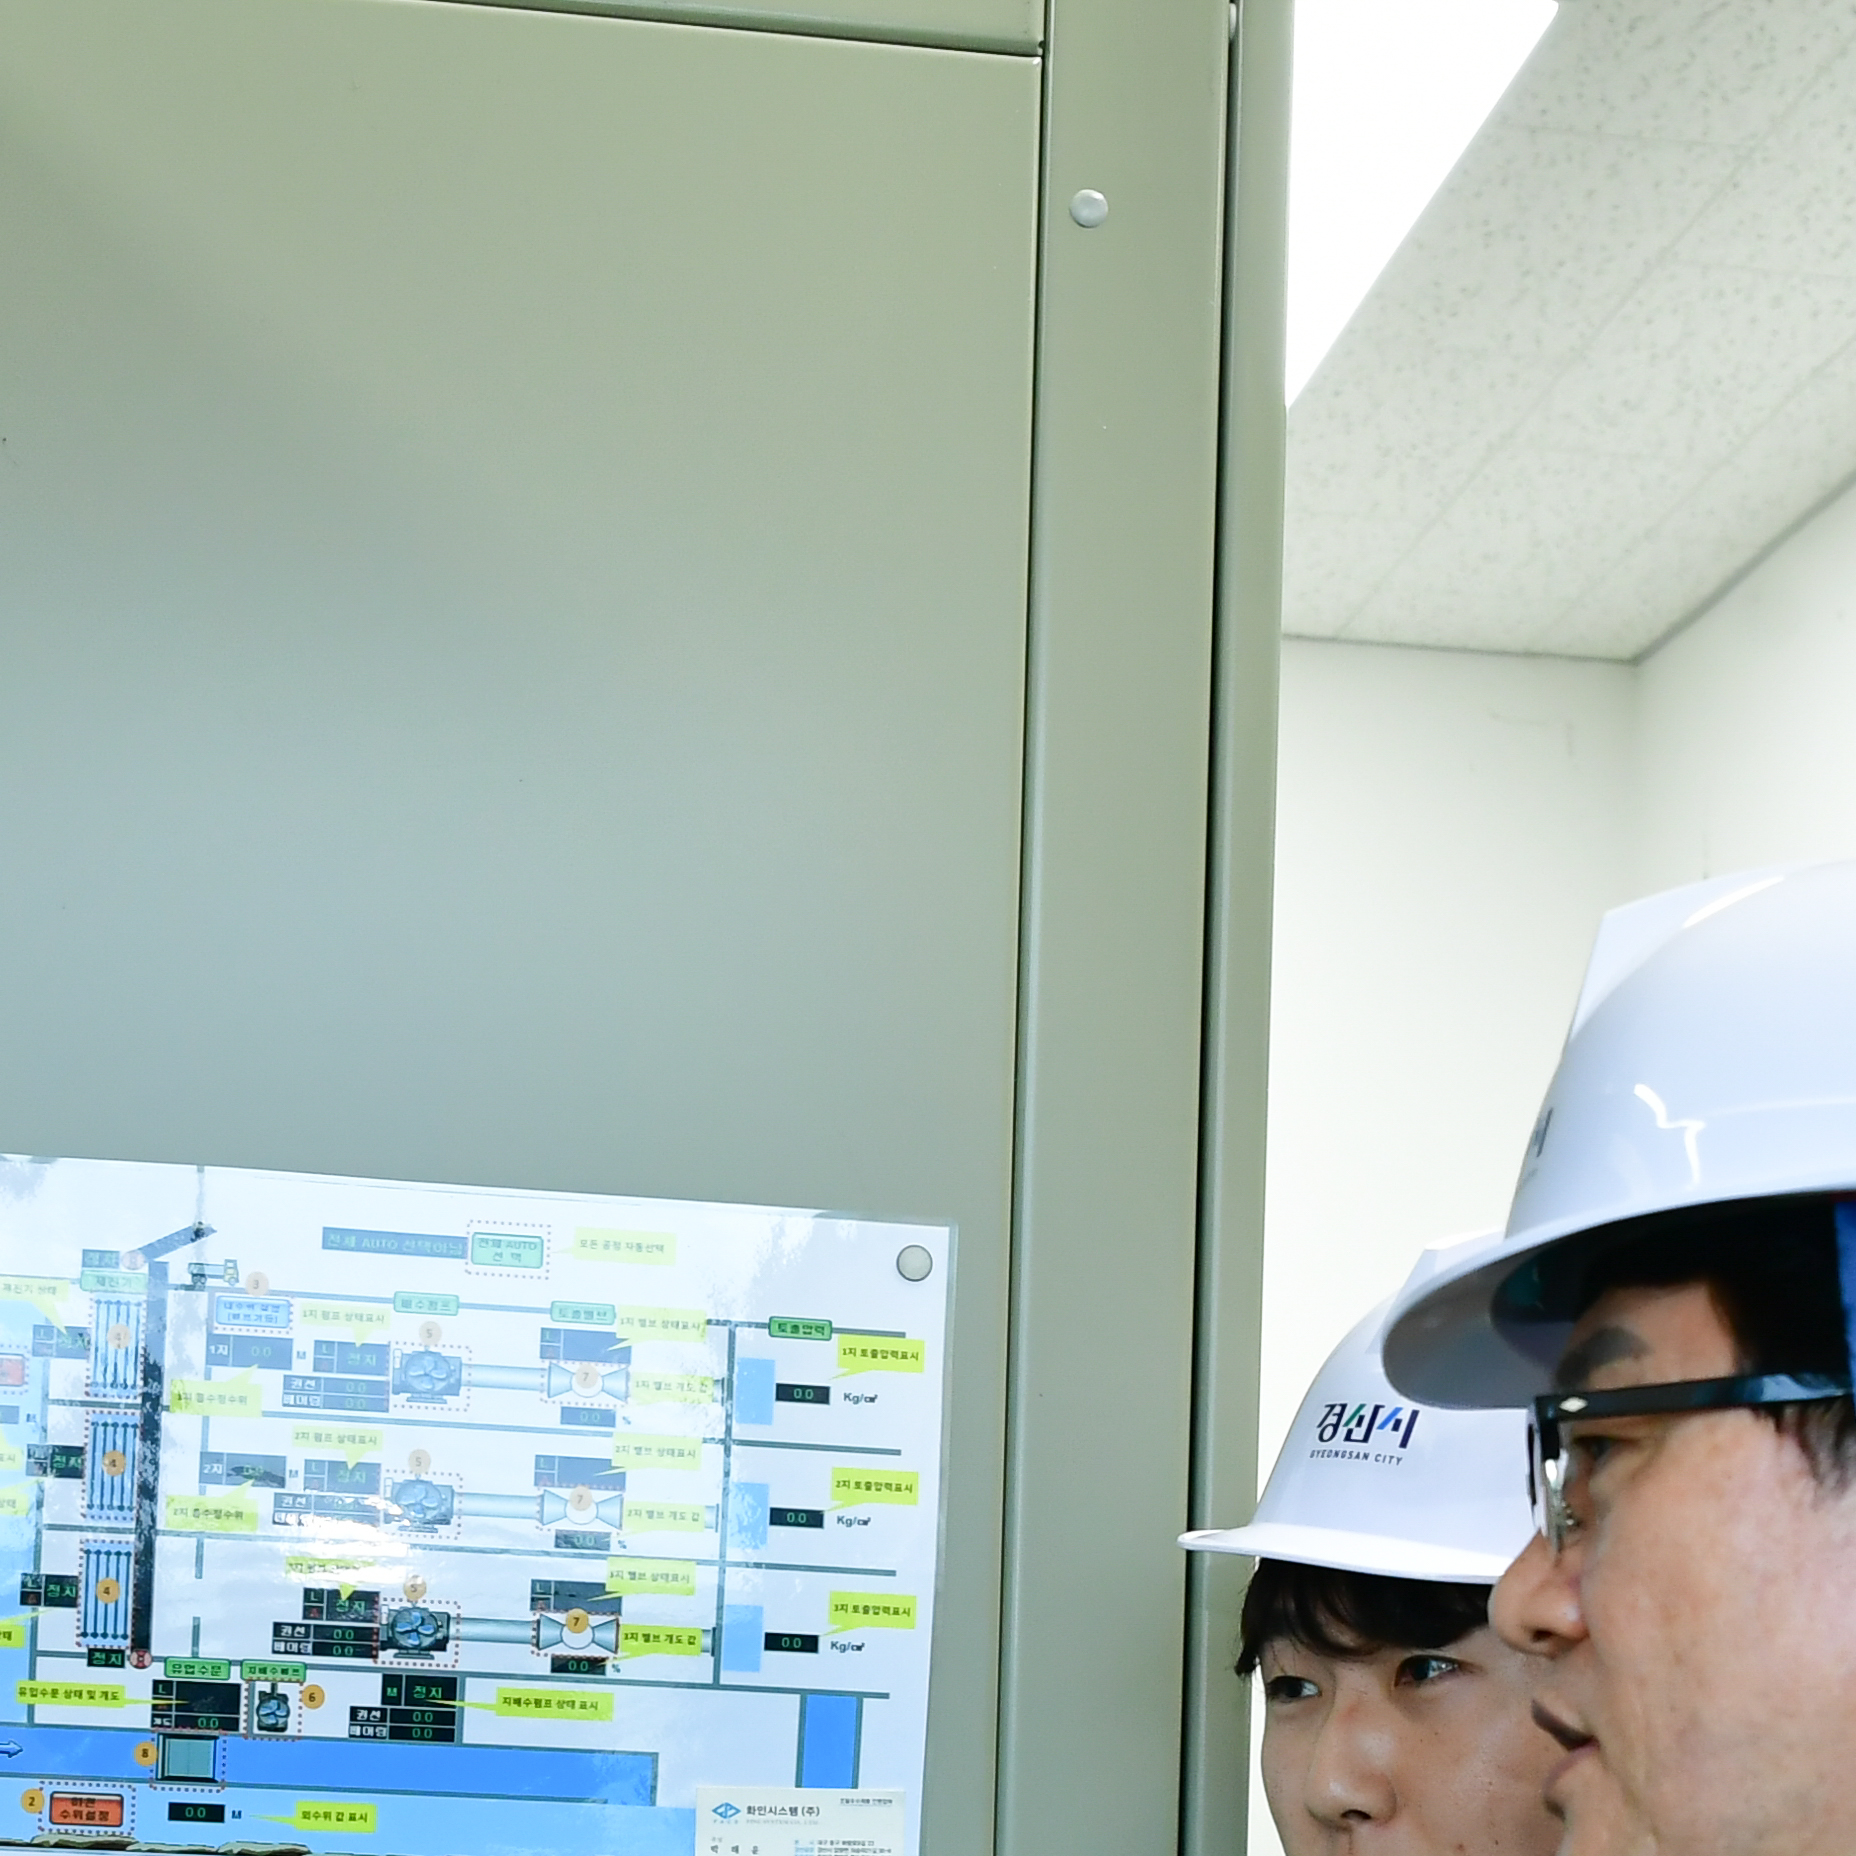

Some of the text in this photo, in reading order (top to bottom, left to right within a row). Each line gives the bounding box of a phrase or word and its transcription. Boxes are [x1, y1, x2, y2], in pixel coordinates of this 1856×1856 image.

[363, 1238, 398, 1249] AUTO
[210, 1345, 228, 1355] 1지
[843, 1347, 919, 1360] 1지 토출압력표시
[1316, 1404, 1420, 1448] 경산시
[1310, 1449, 1403, 1466] GYEONGSAN CITY
[203, 1464, 223, 1474] 2지
[836, 1480, 913, 1493] 2지 토출압력표시
[651, 1573, 689, 1583] 상태표시
[834, 1604, 910, 1616] 3지 토출압력표시
[573, 1617, 580, 1626] 7
[625, 1633, 638, 1641] 3지
[643, 1633, 660, 1643] 밸브
[665, 1635, 682, 1644] 개도
[19, 1688, 120, 1701] 유입수문 상태 및 개도
[309, 1693, 315, 1702] 6
[502, 1697, 598, 1711] 지배수펌프 상태 표시
[29, 1797, 35, 1806] 2
[746, 1806, 819, 1816] 화인시스템 (주)
[302, 1811, 331, 1821] 외수위
[348, 1813, 368, 1823] 표시
